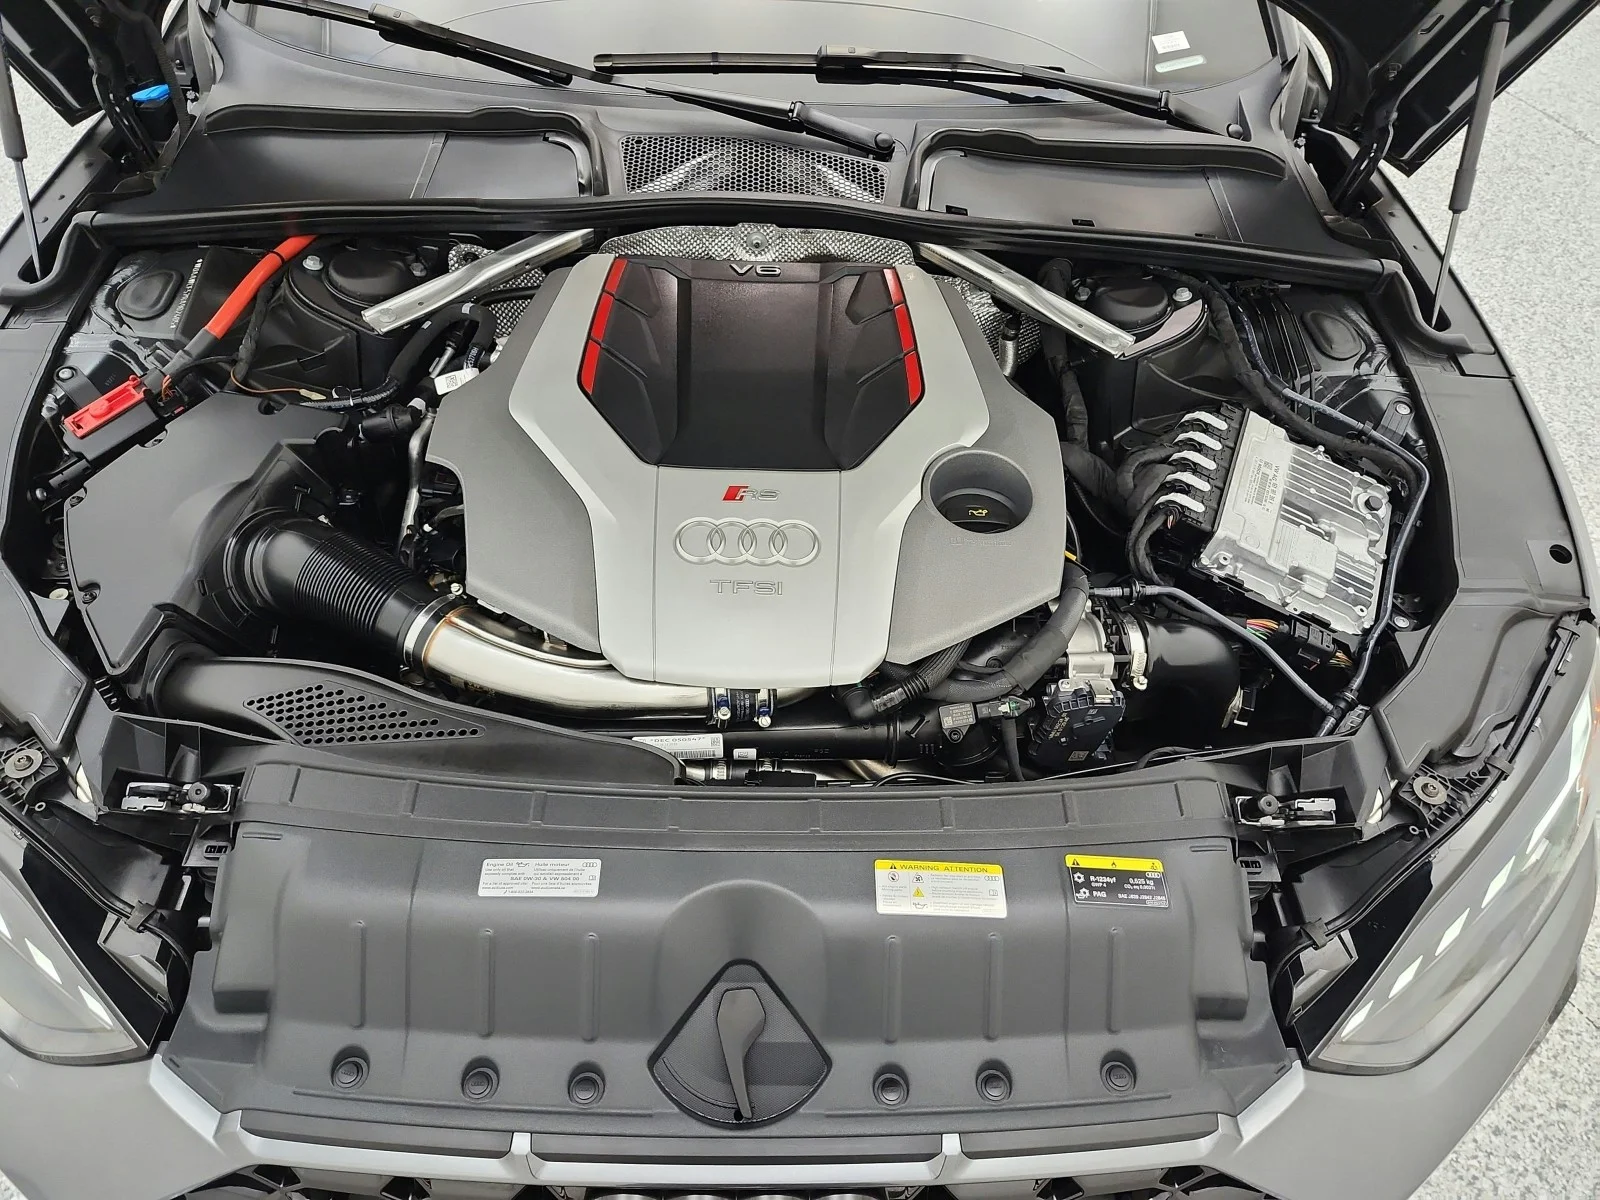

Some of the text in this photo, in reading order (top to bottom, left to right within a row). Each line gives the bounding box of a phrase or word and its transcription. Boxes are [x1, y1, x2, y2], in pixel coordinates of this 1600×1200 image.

[729, 263, 781, 277] V6
[722, 485, 781, 502] RS
[710, 579, 783, 595] TFSI
[1090, 875, 1117, 884] R-1234yf
[1092, 890, 1107, 898] PAG
